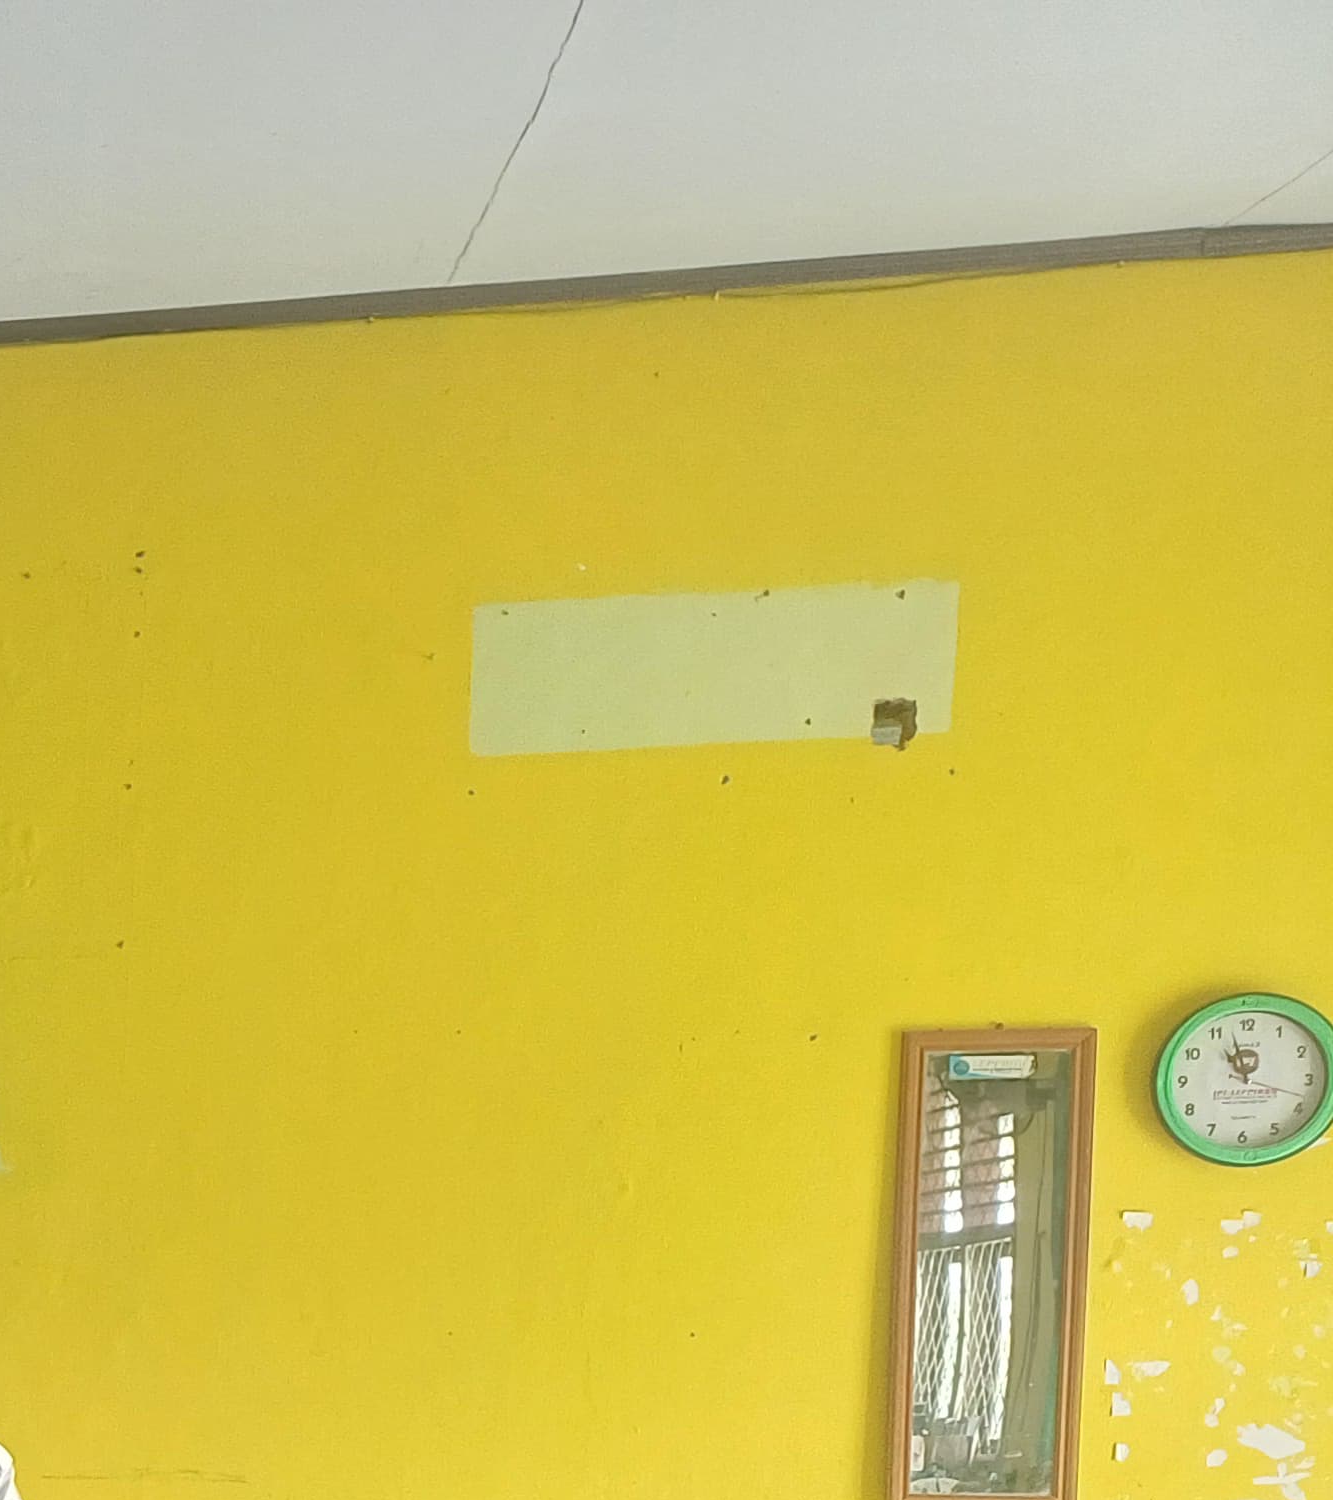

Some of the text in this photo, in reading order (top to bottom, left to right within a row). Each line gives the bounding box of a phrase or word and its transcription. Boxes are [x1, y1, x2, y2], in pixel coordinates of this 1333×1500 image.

[1239, 1018, 1256, 1032] 12
[1275, 1025, 1283, 1038] 1
[1208, 1027, 1223, 1041] 11
[1185, 1047, 1201, 1061] 10
[1296, 1046, 1307, 1059] 2
[1177, 1075, 1189, 1089] 9
[1304, 1073, 1314, 1087] 3
[1184, 1103, 1195, 1117] 8
[1206, 1123, 1217, 1137] 7
[1269, 1122, 1280, 1136] 5
[1237, 1130, 1248, 1144] 6
